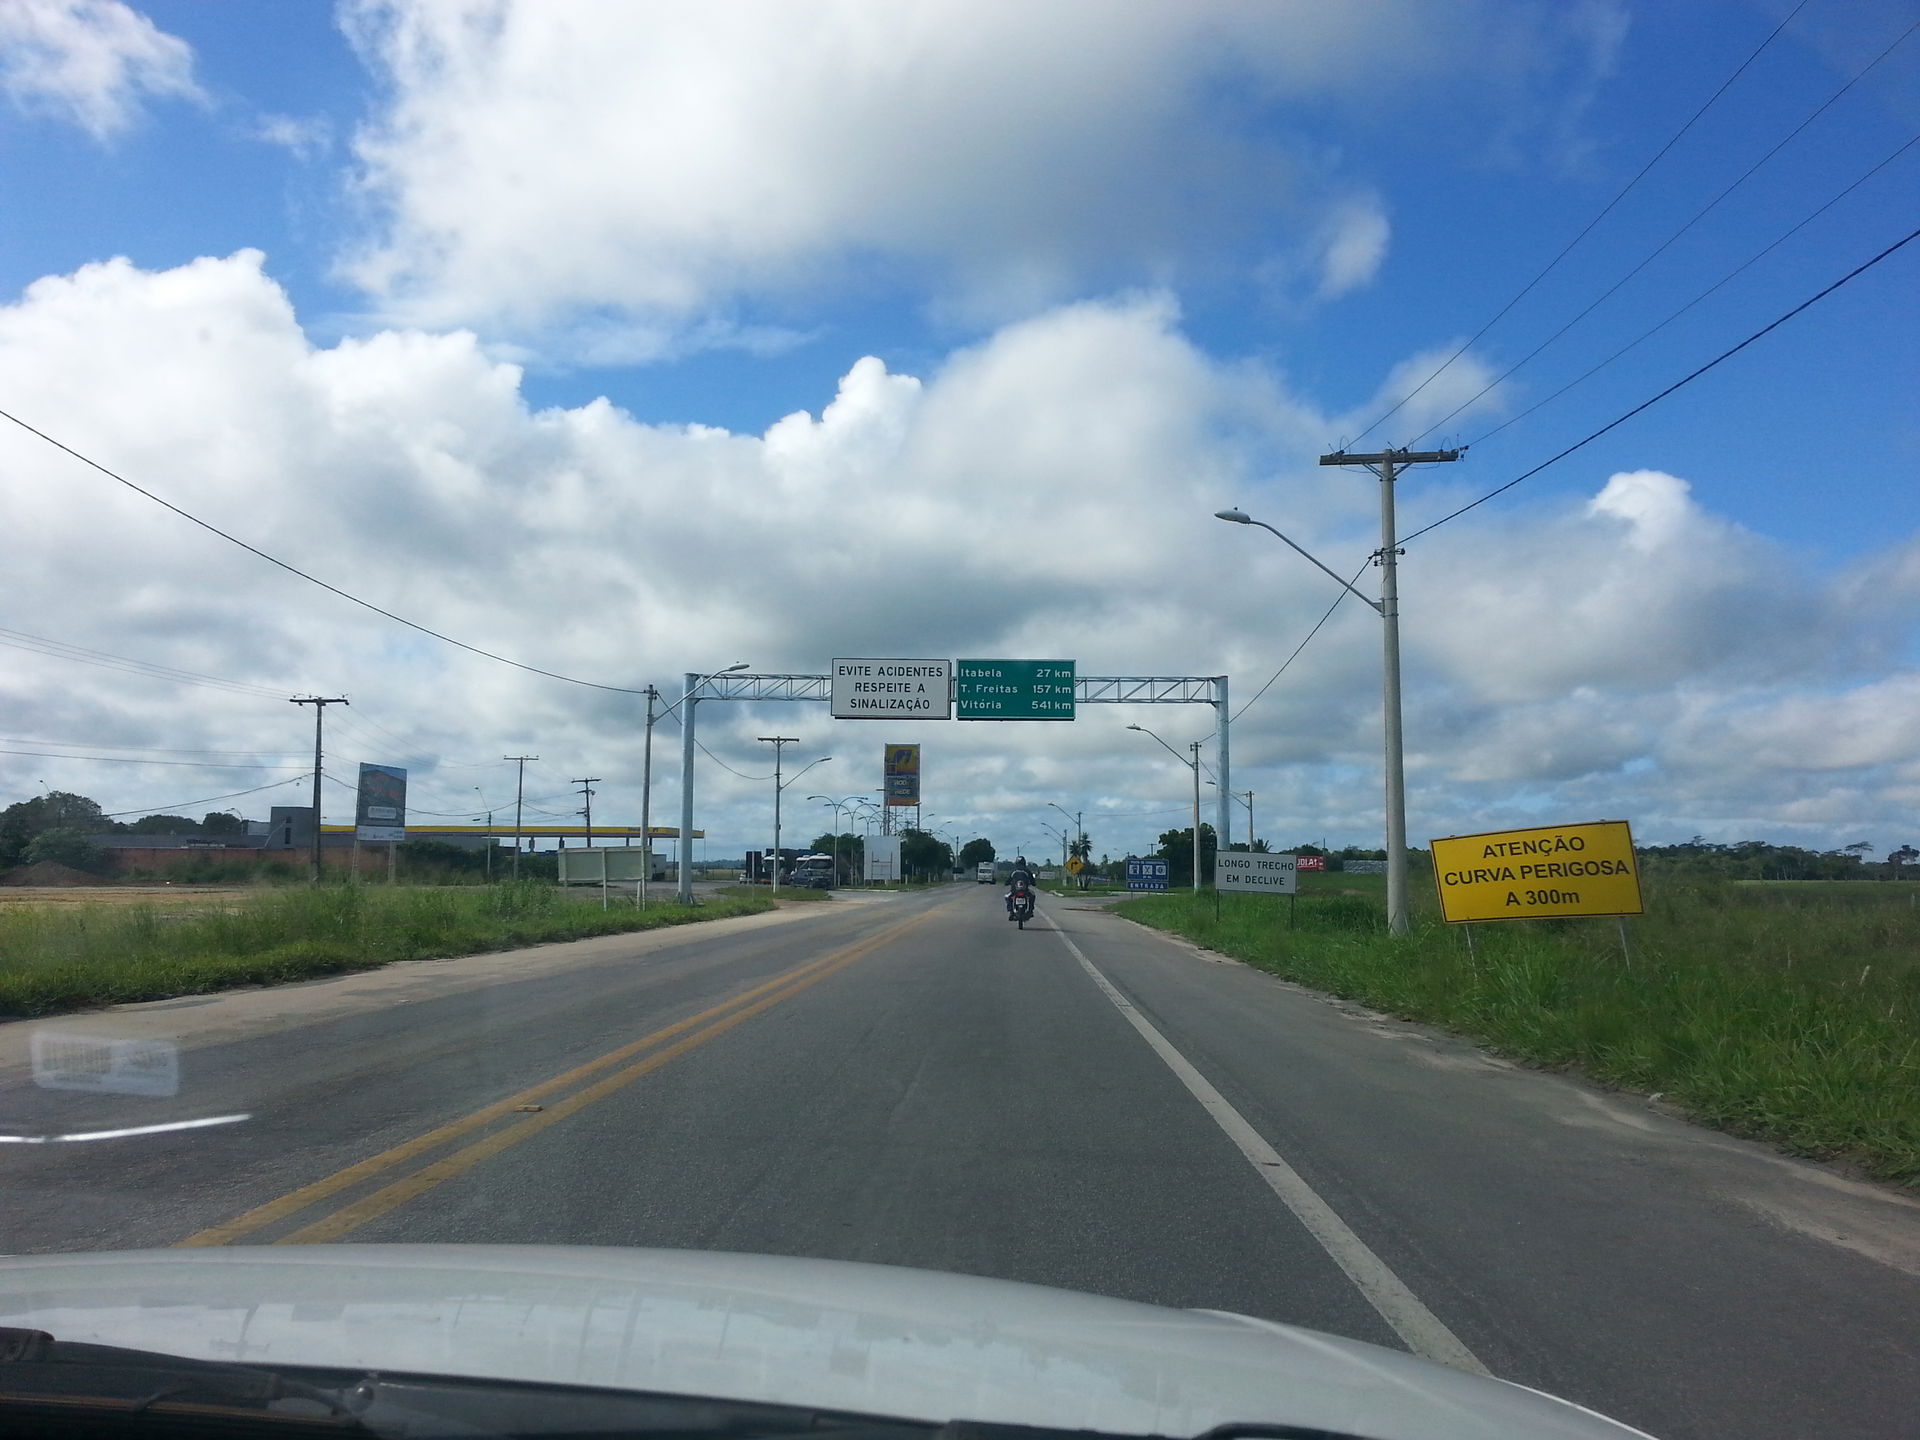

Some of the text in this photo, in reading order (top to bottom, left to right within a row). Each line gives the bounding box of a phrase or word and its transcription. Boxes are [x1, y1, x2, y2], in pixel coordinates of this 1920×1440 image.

[838, 665, 943, 677] EVITE ACIDENTES
[960, 668, 1071, 678] Itabela 27 km
[855, 682, 926, 693] RESPEITE A
[960, 684, 1071, 694] T. Freitas 157 km
[850, 697, 930, 711] SINALIZAÇÃO
[960, 699, 1071, 710] Vitória 541 km
[1482, 835, 1585, 859] ATENÇÃO
[1218, 859, 1294, 871] LONGO TRECHO
[1444, 860, 1630, 886] CURVA PERIGOSA
[1226, 874, 1285, 886] EM DECLIVE
[1505, 889, 1580, 906] A 300m
